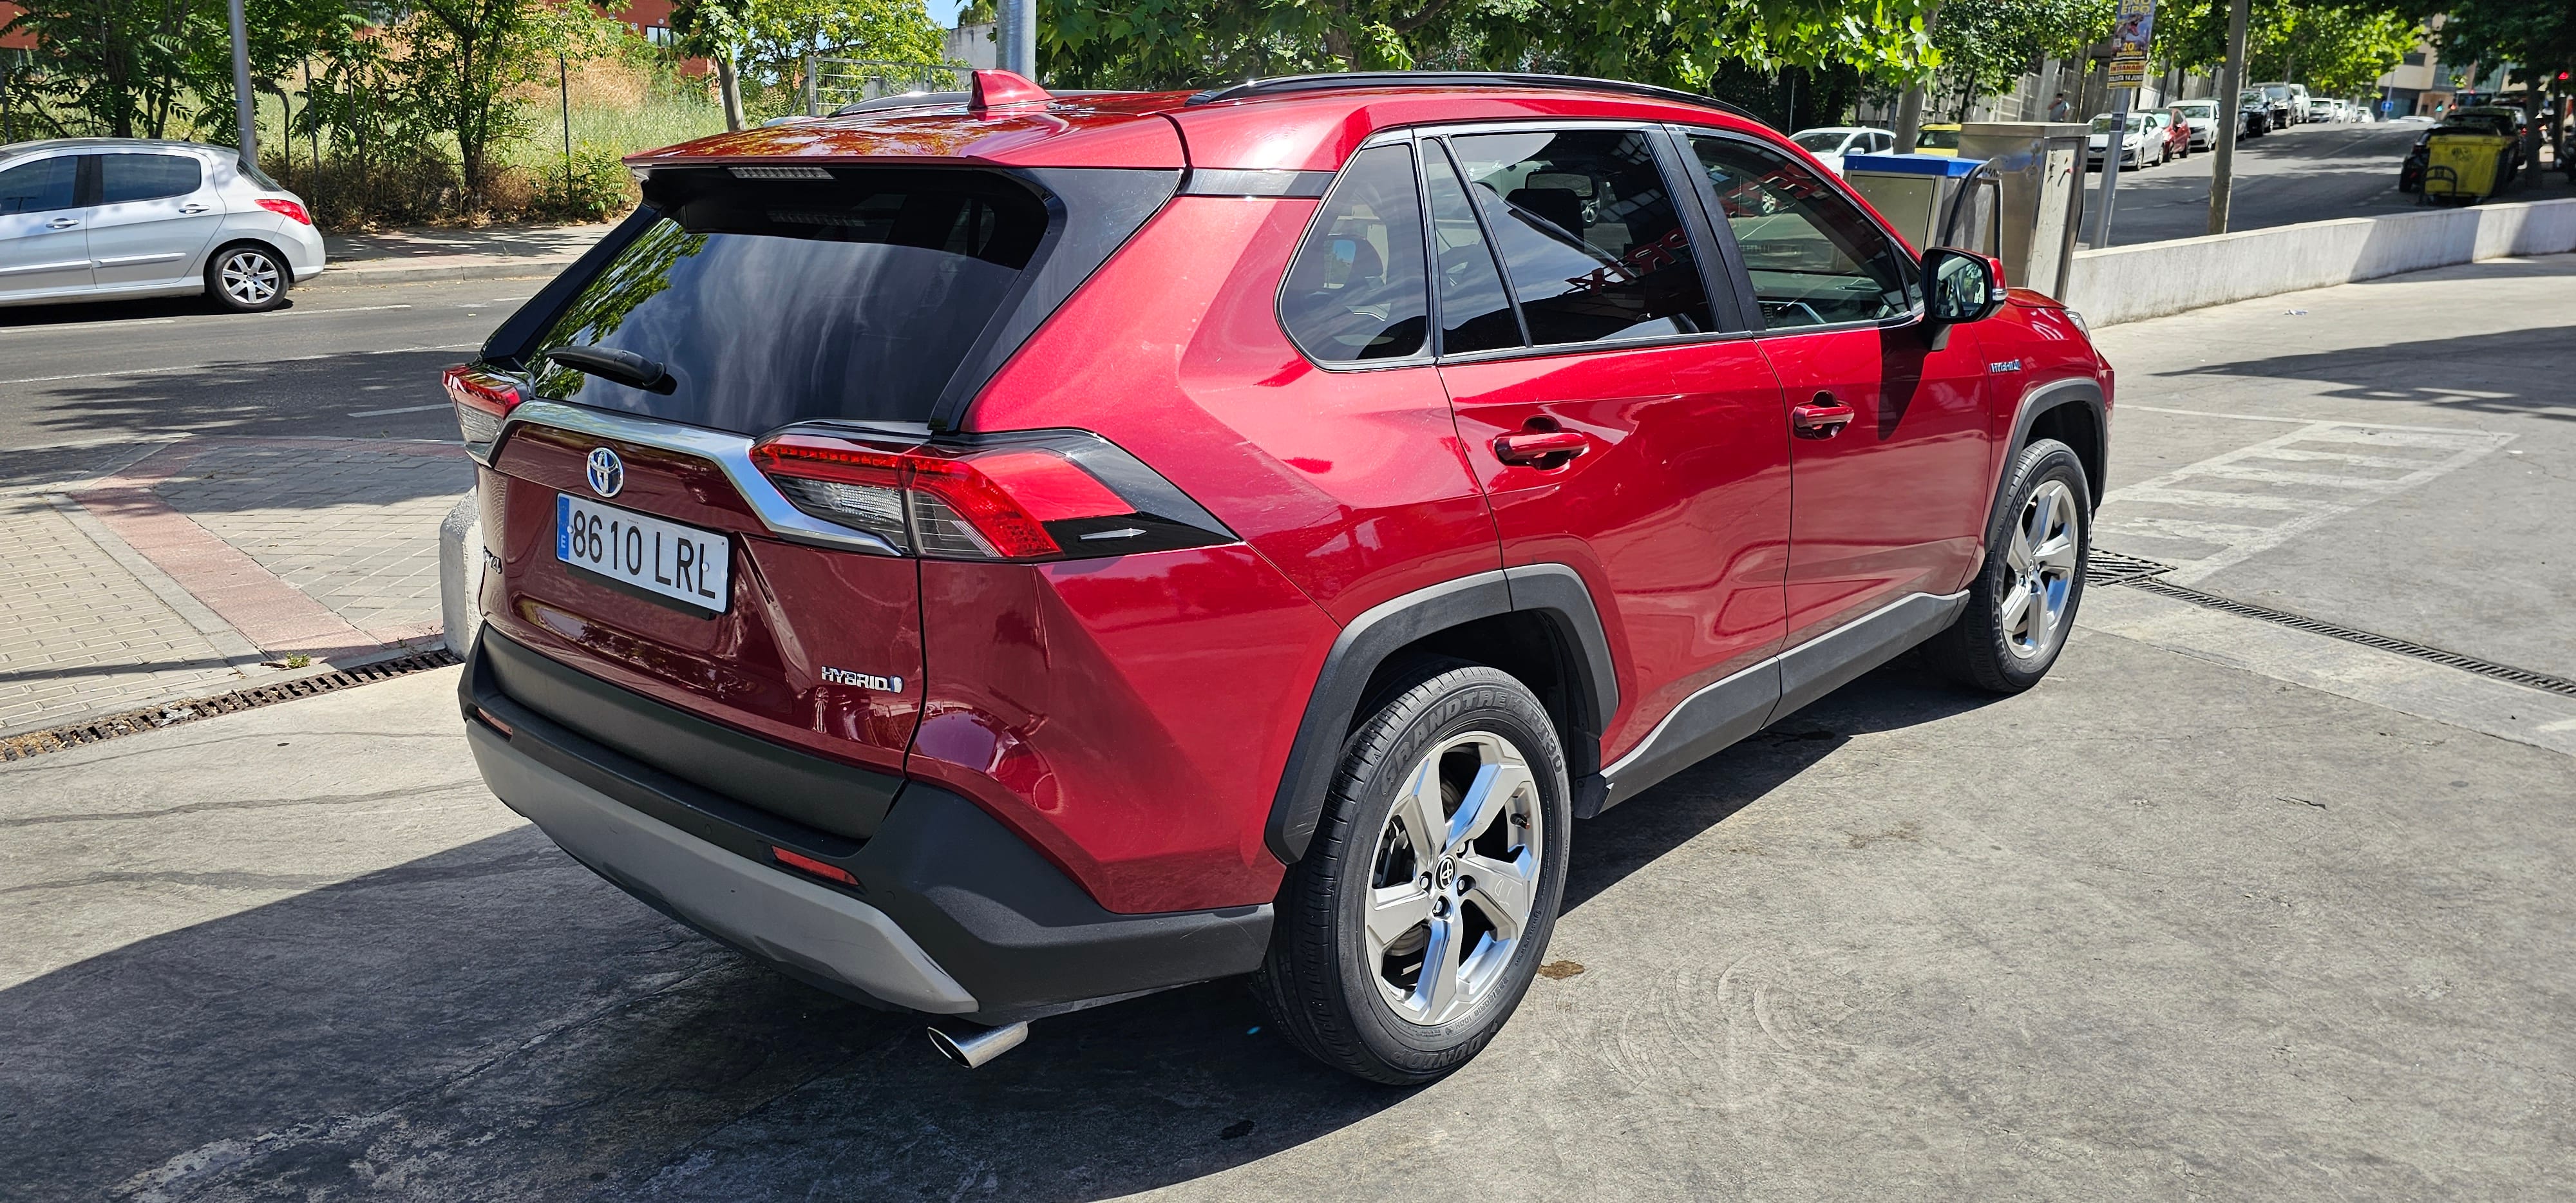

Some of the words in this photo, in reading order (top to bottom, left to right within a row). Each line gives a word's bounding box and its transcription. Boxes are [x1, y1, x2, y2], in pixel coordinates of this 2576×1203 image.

[2123, 42, 2135, 52] 20
[560, 535, 567, 549] E
[573, 509, 642, 576] 8610
[655, 531, 716, 600] LRL
[821, 666, 889, 691] HYBRID
[1380, 690, 1524, 796] GRANDTREK
[1390, 1032, 1484, 1070] DUNLOP
